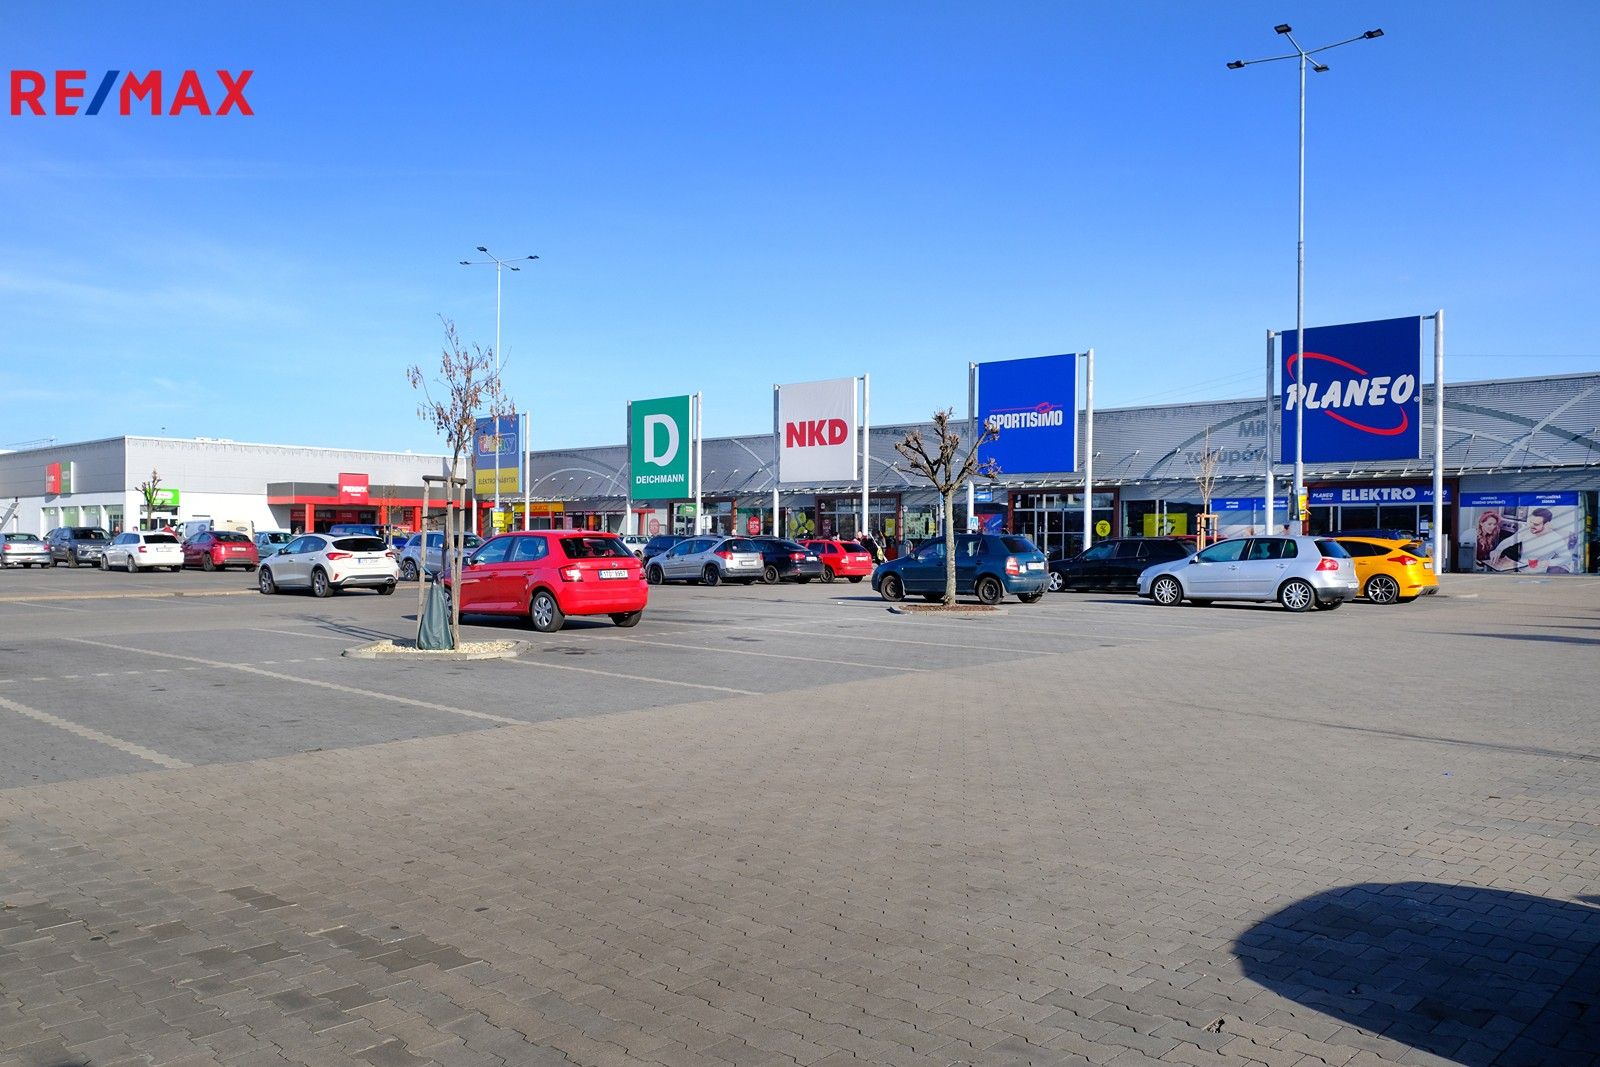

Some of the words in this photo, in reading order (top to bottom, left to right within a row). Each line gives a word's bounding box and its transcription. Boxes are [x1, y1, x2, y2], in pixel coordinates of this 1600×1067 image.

[1285, 374, 1415, 411] PLANEO
[988, 410, 1063, 430] SPORTISIMO
[643, 413, 680, 467] D
[785, 418, 849, 449] NKD
[636, 474, 685, 484] DEICHMANN
[1341, 487, 1416, 501] ELEKTRO
